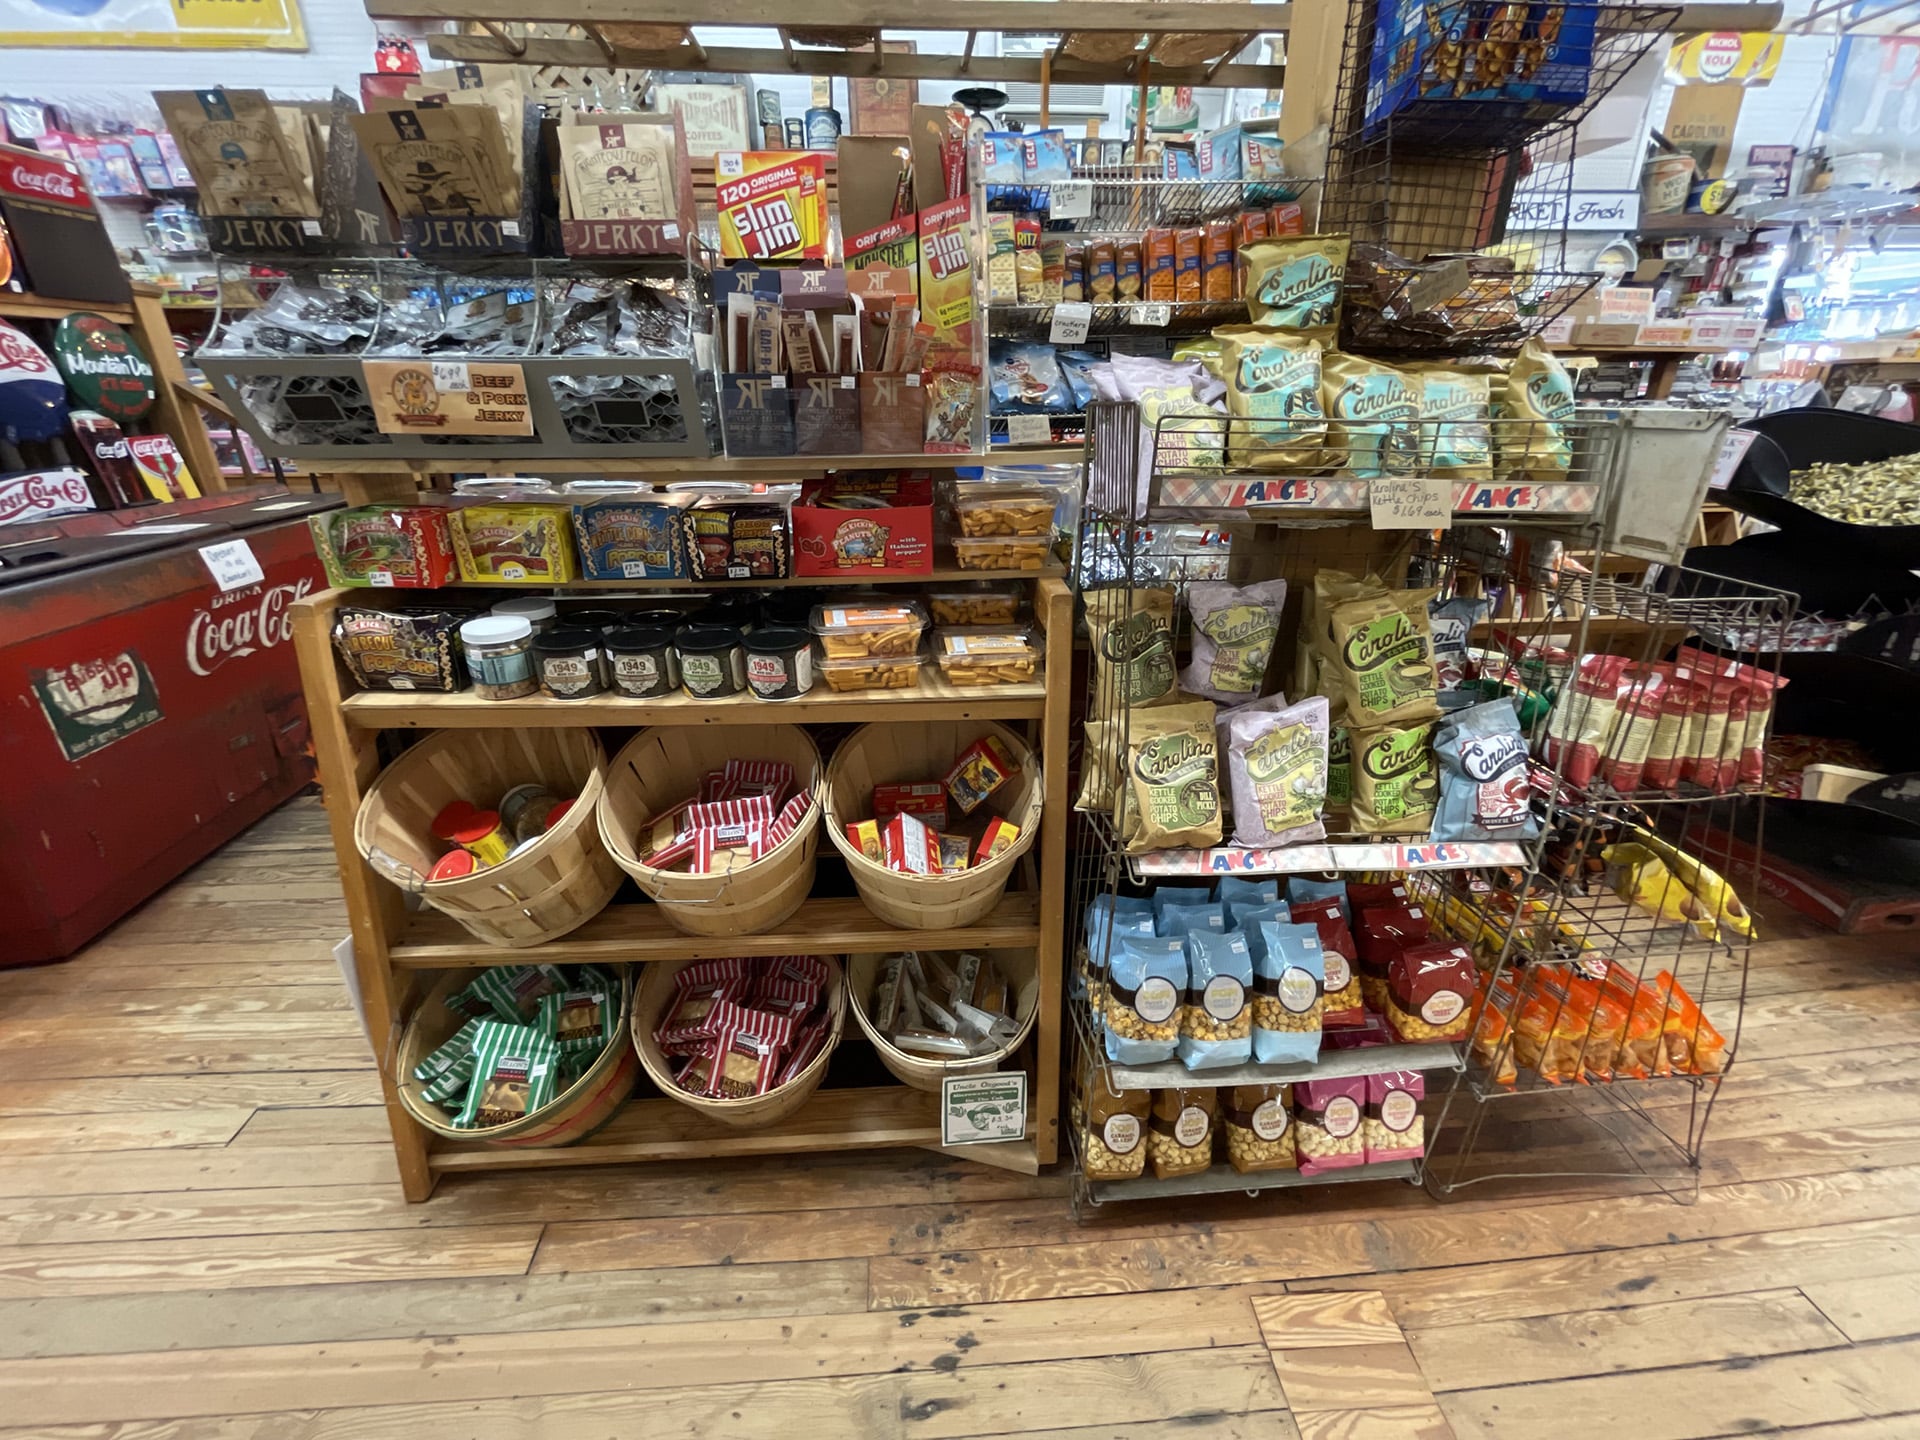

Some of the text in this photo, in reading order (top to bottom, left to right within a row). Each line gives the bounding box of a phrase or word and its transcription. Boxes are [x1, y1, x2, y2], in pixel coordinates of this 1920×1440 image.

[1705, 55, 1732, 66] KOLA
[721, 167, 797, 204] 120 ORIGINAL
[923, 206, 966, 227] ORIGINAL
[1574, 199, 1625, 222] Fresh
[222, 220, 304, 247] JERKY
[420, 221, 504, 247] JERKY
[578, 224, 660, 249] JERKY
[1017, 232, 1037, 246] RITZ
[1255, 260, 1344, 309] Carolina
[66, 353, 128, 375] Mountain
[472, 374, 514, 388] BEEF
[467, 392, 527, 405] & PORK
[1333, 378, 1419, 427] Carolina
[475, 409, 525, 422] JERKY
[1229, 480, 1308, 508] LANCE
[1457, 483, 1531, 510] LANCE
[832, 531, 872, 550] PEANUTS
[607, 551, 668, 569] POPCOR
[552, 663, 577, 673] 1949
[622, 661, 646, 671] 1949
[687, 661, 711, 672] 1949
[753, 661, 775, 672] 1949
[1361, 698, 1389, 708] CHIPS
[1135, 739, 1214, 785] Carolina
[1245, 729, 1325, 782] Carolina
[1149, 788, 1176, 796] KETTLE
[1150, 813, 1179, 823] CHIPS
[1260, 808, 1288, 818] CHIPS
[1374, 805, 1400, 815] CHIPS
[1201, 850, 1269, 873] LANCE
[1397, 844, 1461, 869] LANCE
